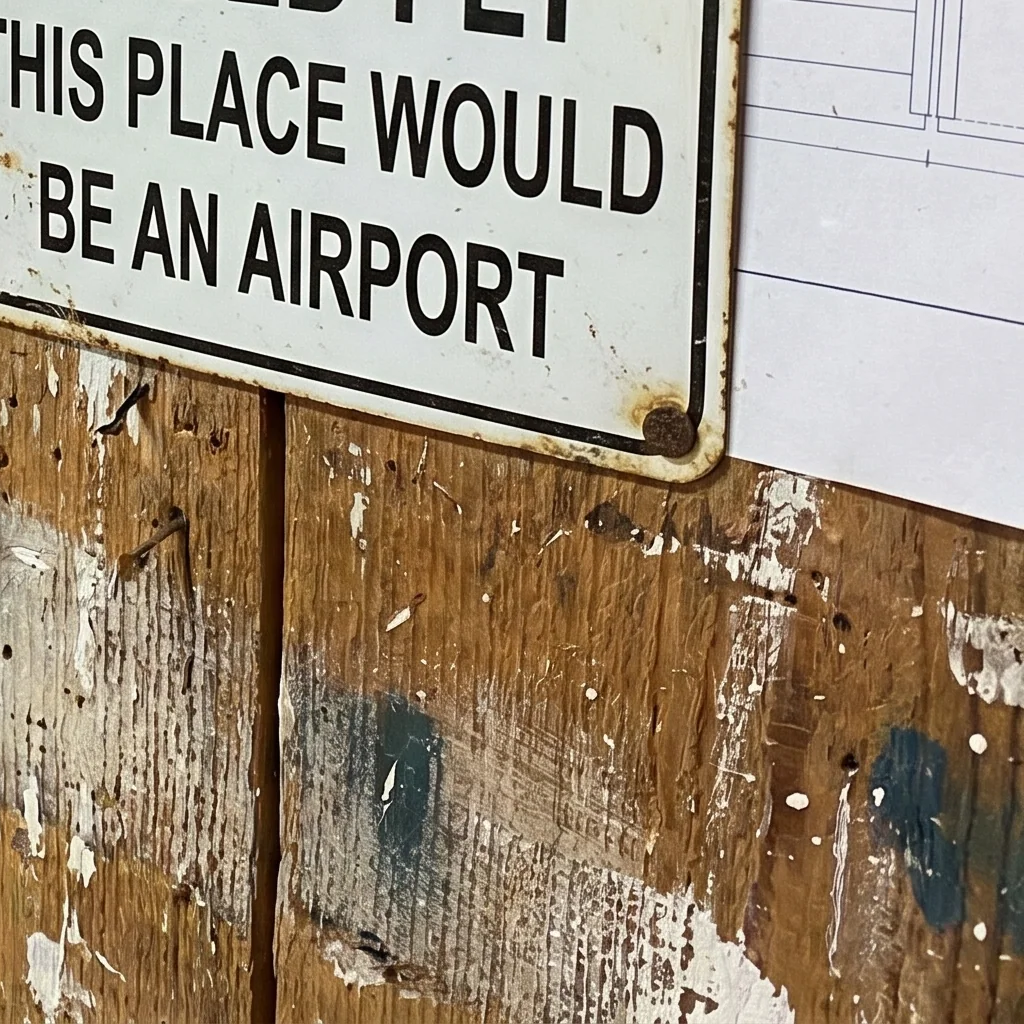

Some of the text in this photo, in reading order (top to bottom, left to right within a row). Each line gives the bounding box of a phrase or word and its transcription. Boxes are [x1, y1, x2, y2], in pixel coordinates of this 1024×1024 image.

[128, 36, 346, 165] PLACE
[370, 70, 664, 216] WOULD
[40, 161, 565, 360] BE AN AIRPORT
